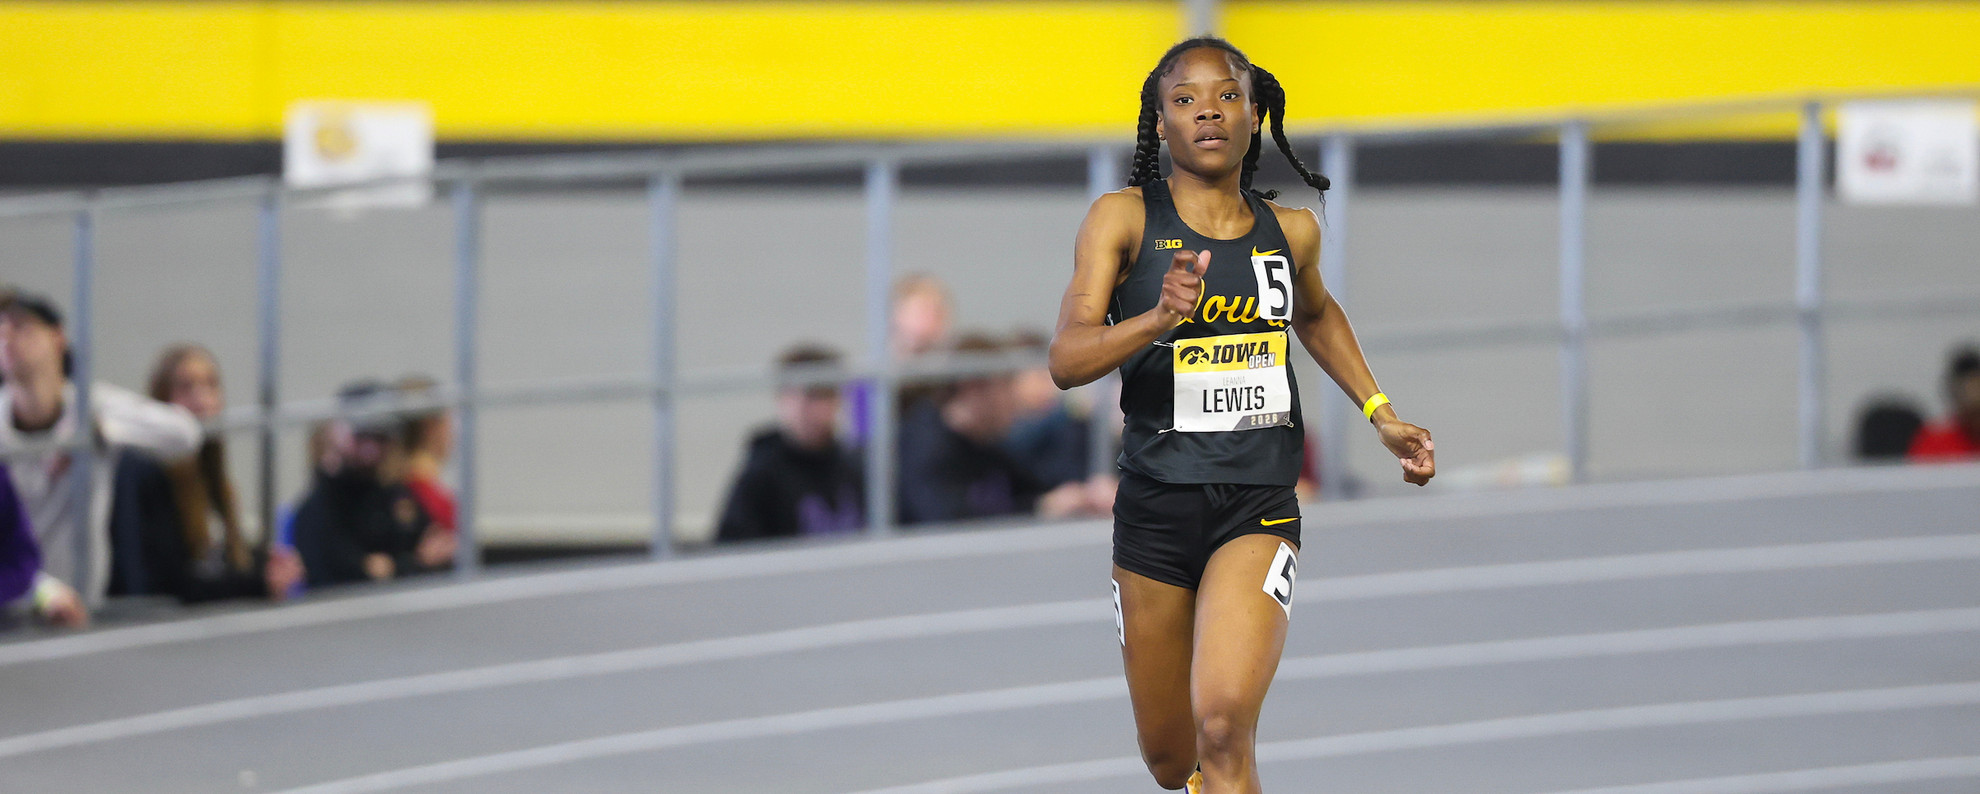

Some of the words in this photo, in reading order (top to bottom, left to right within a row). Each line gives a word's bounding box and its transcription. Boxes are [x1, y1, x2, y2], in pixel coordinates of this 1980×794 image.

[1154, 238, 1183, 250] B1G
[1264, 260, 1289, 316] 5
[1211, 341, 1269, 364] IOWA
[1248, 352, 1275, 369] OPEN
[1203, 385, 1265, 413] LEWIS
[1274, 553, 1296, 605] 5
